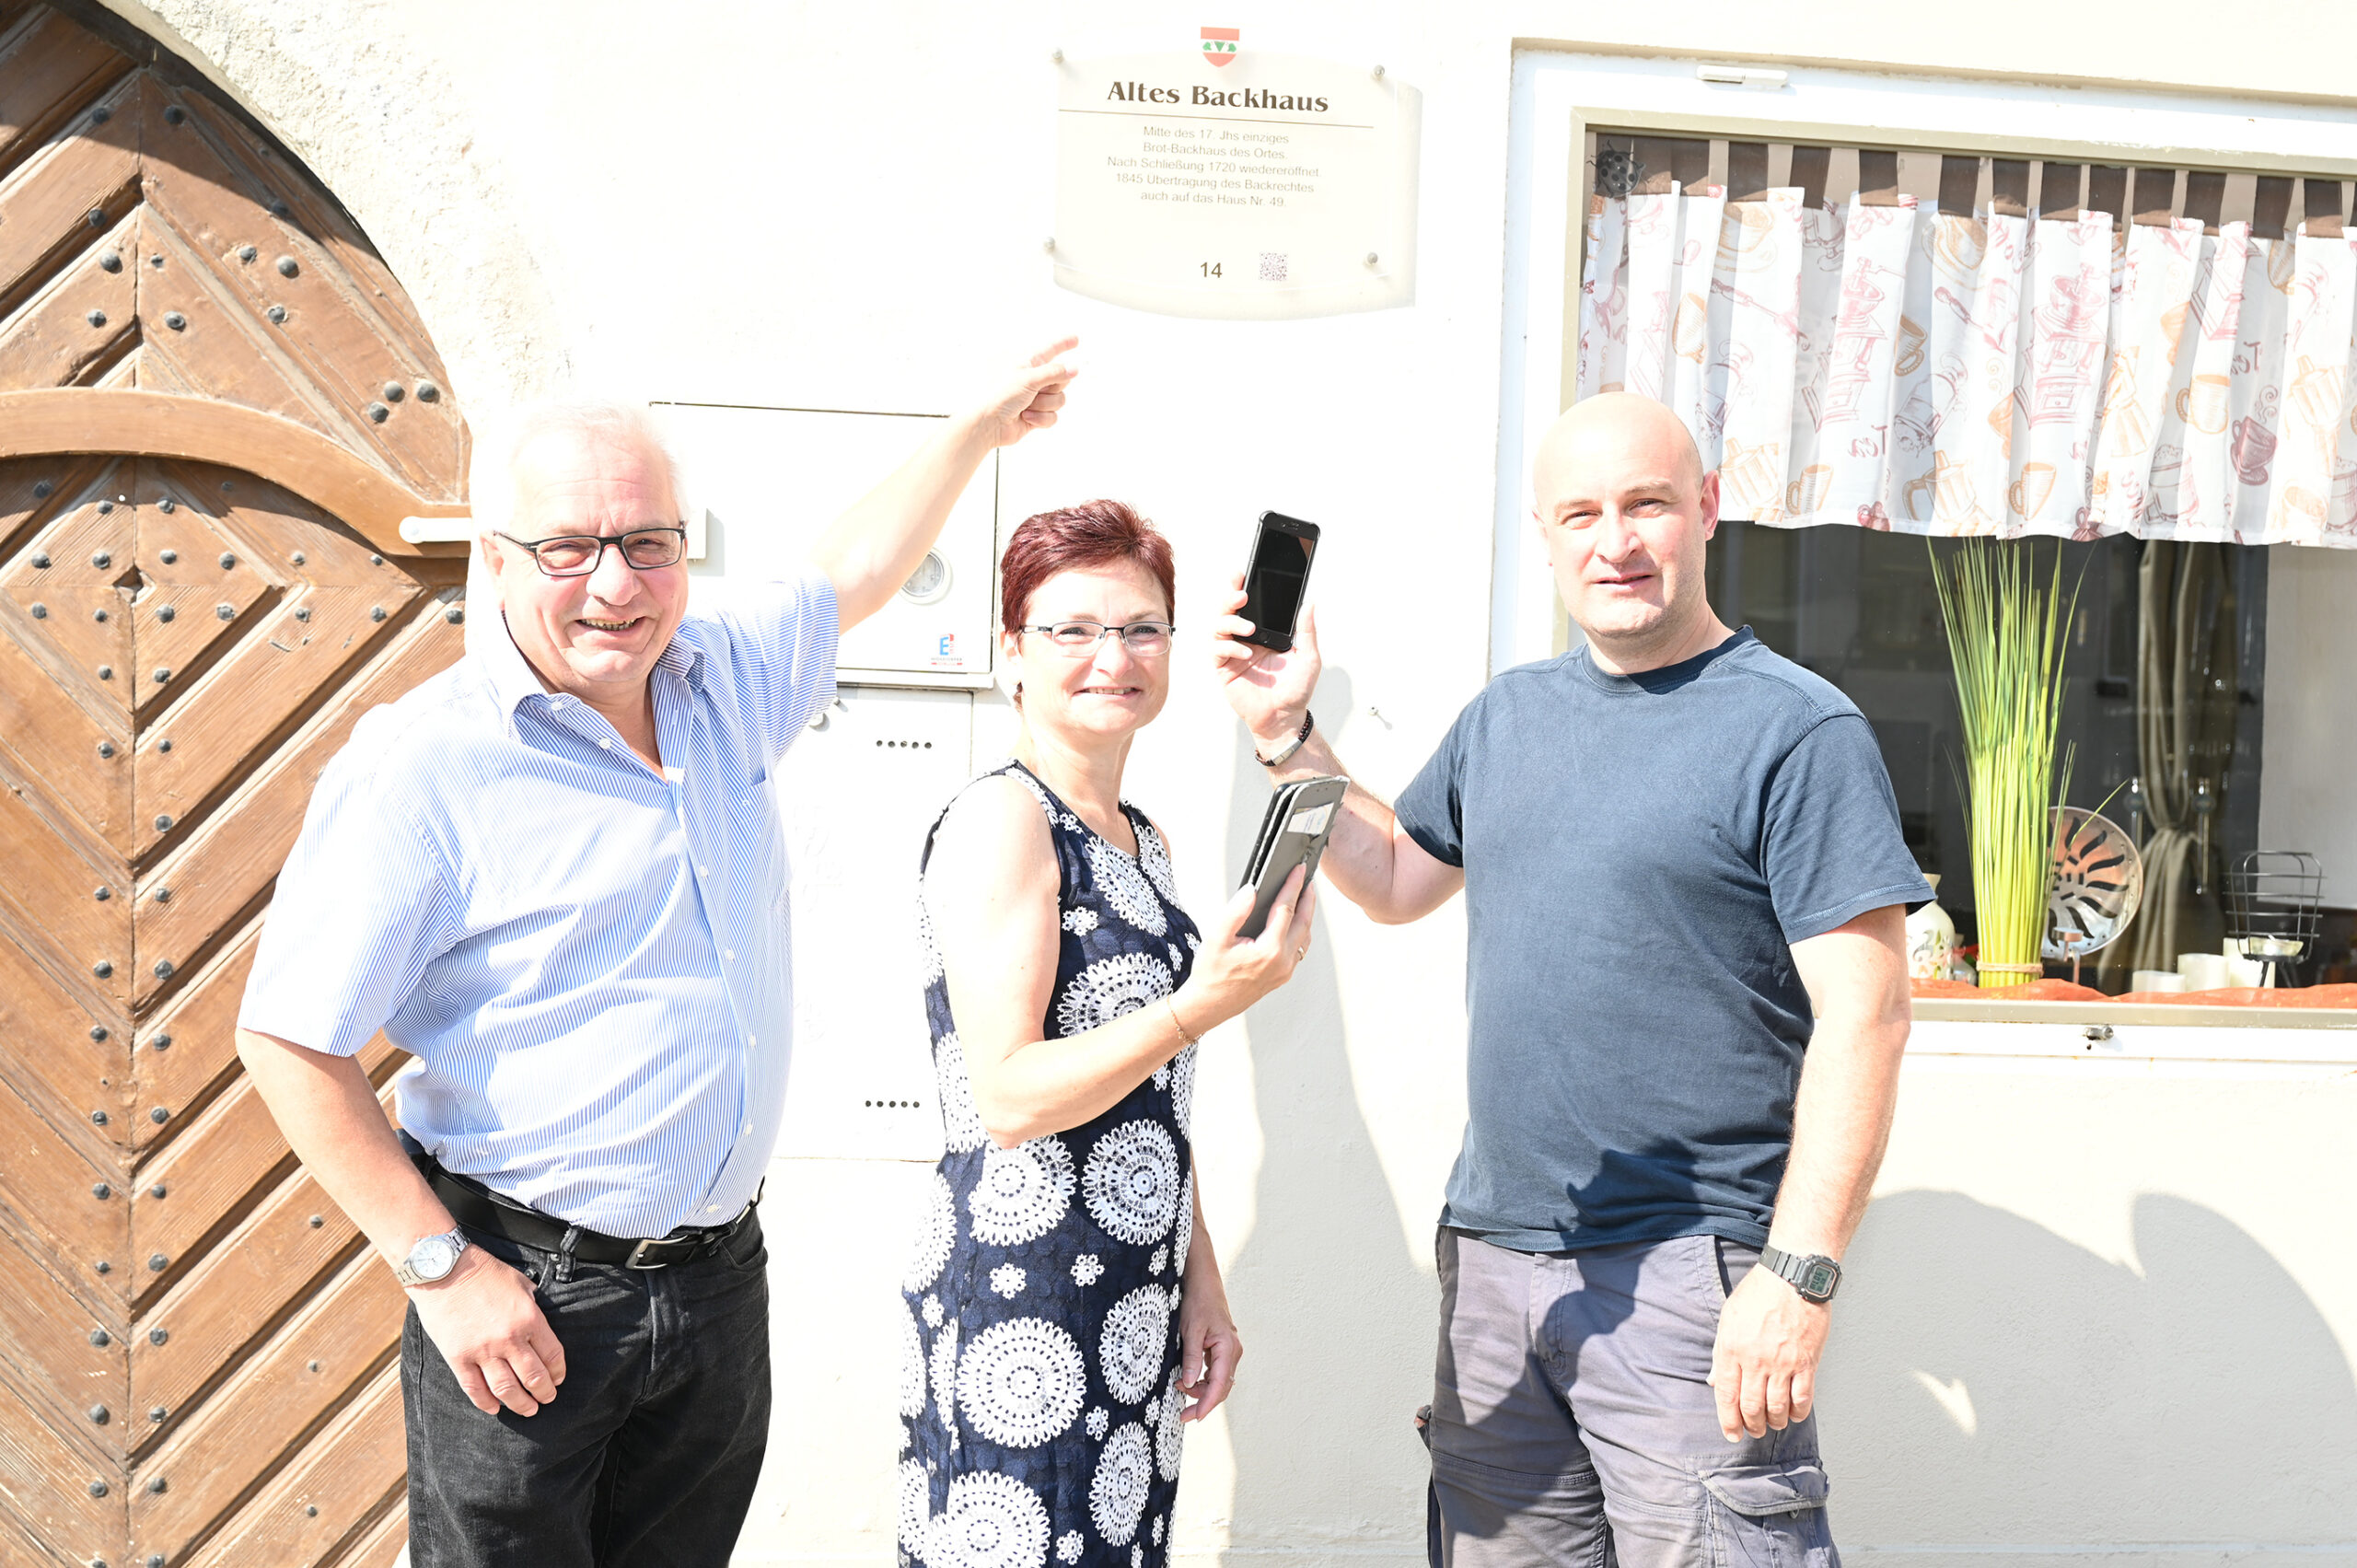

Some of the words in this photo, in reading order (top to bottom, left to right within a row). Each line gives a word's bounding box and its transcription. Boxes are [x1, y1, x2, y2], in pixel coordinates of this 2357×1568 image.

[1107, 80, 1180, 104] Altes
[1191, 84, 1329, 112] Backhaus
[1143, 125, 1171, 137] Mitte
[1174, 128, 1196, 139] des
[1242, 132, 1289, 145] einziges
[1143, 142, 1226, 157] Brot-Backhaus
[1229, 147, 1250, 157] des
[1254, 147, 1288, 159] Ortes.
[1108, 156, 1137, 168] Nach
[1141, 157, 1204, 173] Schließung
[1209, 161, 1237, 173] 1720
[1116, 172, 1144, 183] 1845
[1220, 178, 1241, 189] des
[1245, 179, 1315, 192] Backrechtes
[1141, 191, 1168, 201] auch
[1171, 192, 1190, 203] auf
[1192, 192, 1213, 203] das
[1217, 193, 1247, 205] Haus
[1250, 195, 1266, 206] Nr.
[1269, 196, 1287, 208] 49.
[1200, 261, 1223, 279] 14
